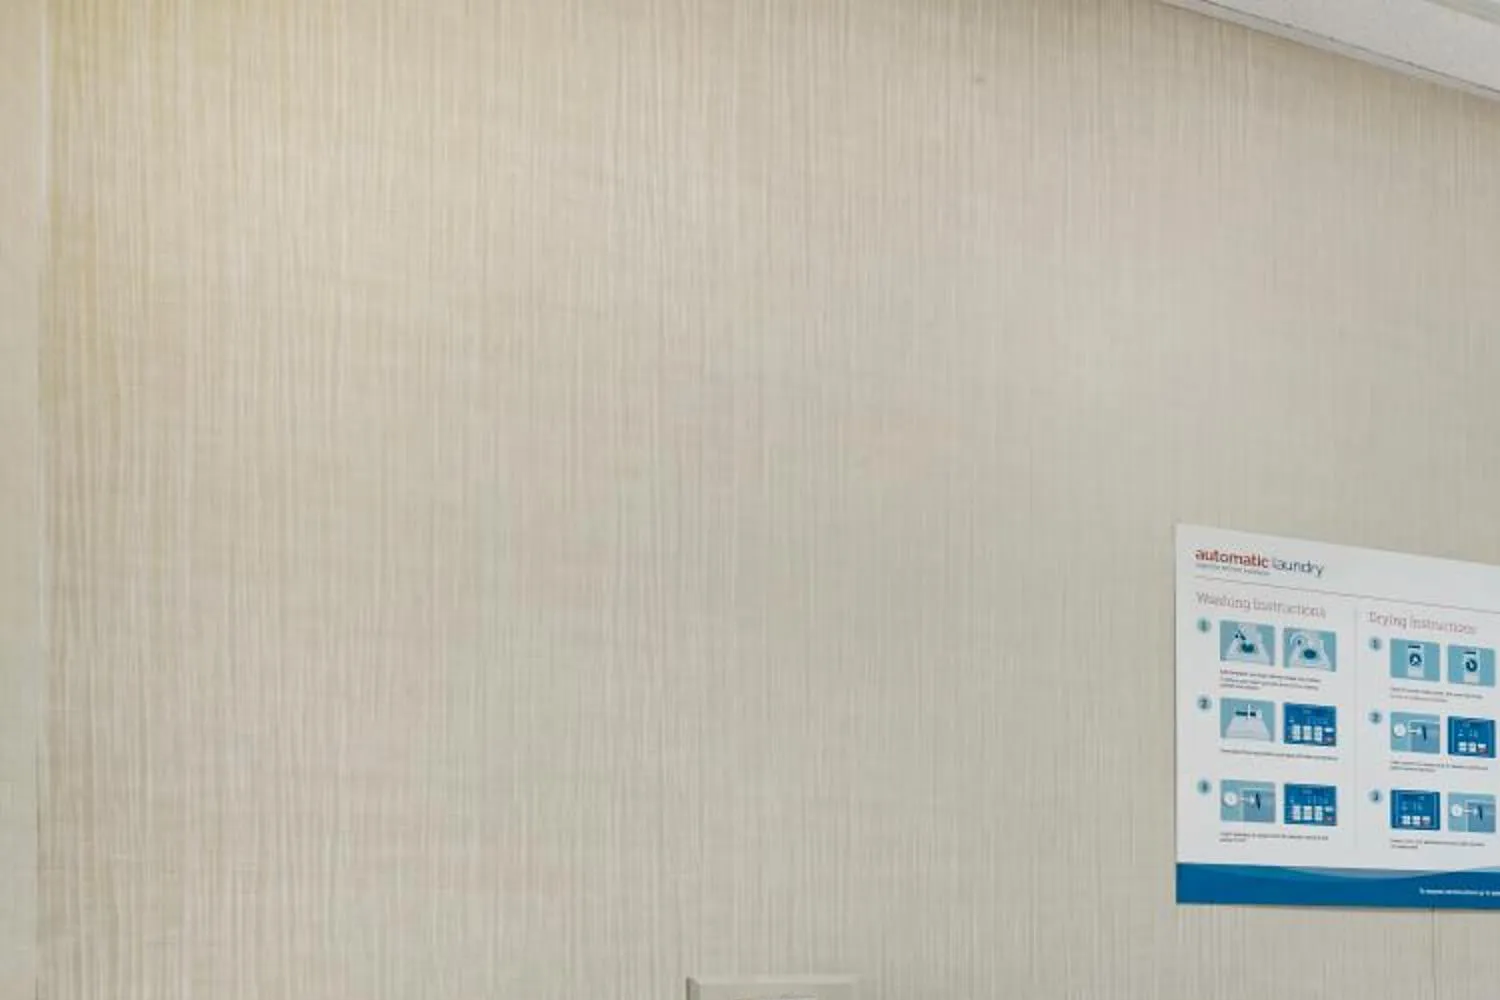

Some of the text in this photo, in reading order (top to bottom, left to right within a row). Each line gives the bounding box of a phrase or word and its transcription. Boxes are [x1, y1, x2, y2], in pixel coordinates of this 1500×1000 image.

[1194, 549, 1269, 569] automatic
[1272, 558, 1325, 578] laundry
[1196, 591, 1251, 612] Washing
